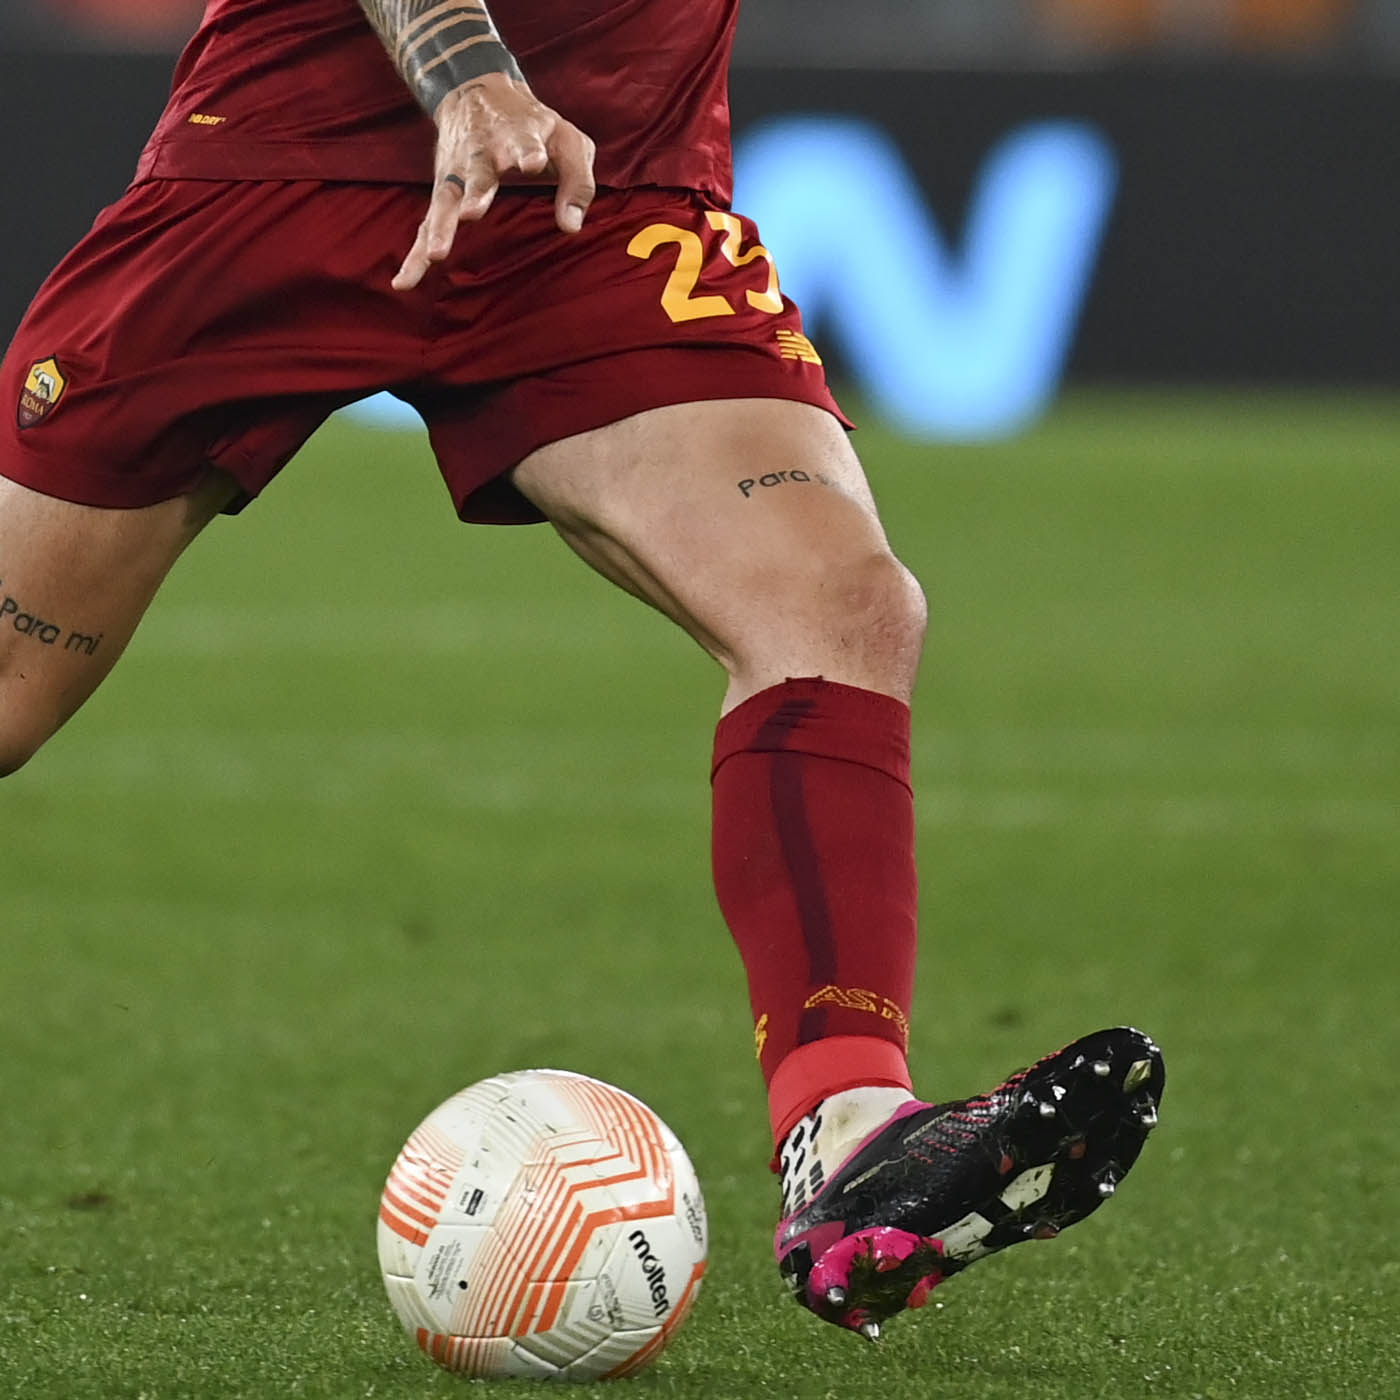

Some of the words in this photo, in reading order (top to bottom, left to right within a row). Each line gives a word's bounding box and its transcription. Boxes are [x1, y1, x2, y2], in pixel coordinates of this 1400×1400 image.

[626, 211, 784, 323] 23
[737, 470, 810, 498] Para
[64, 632, 104, 656] mi
[628, 1230, 671, 1318] molten
